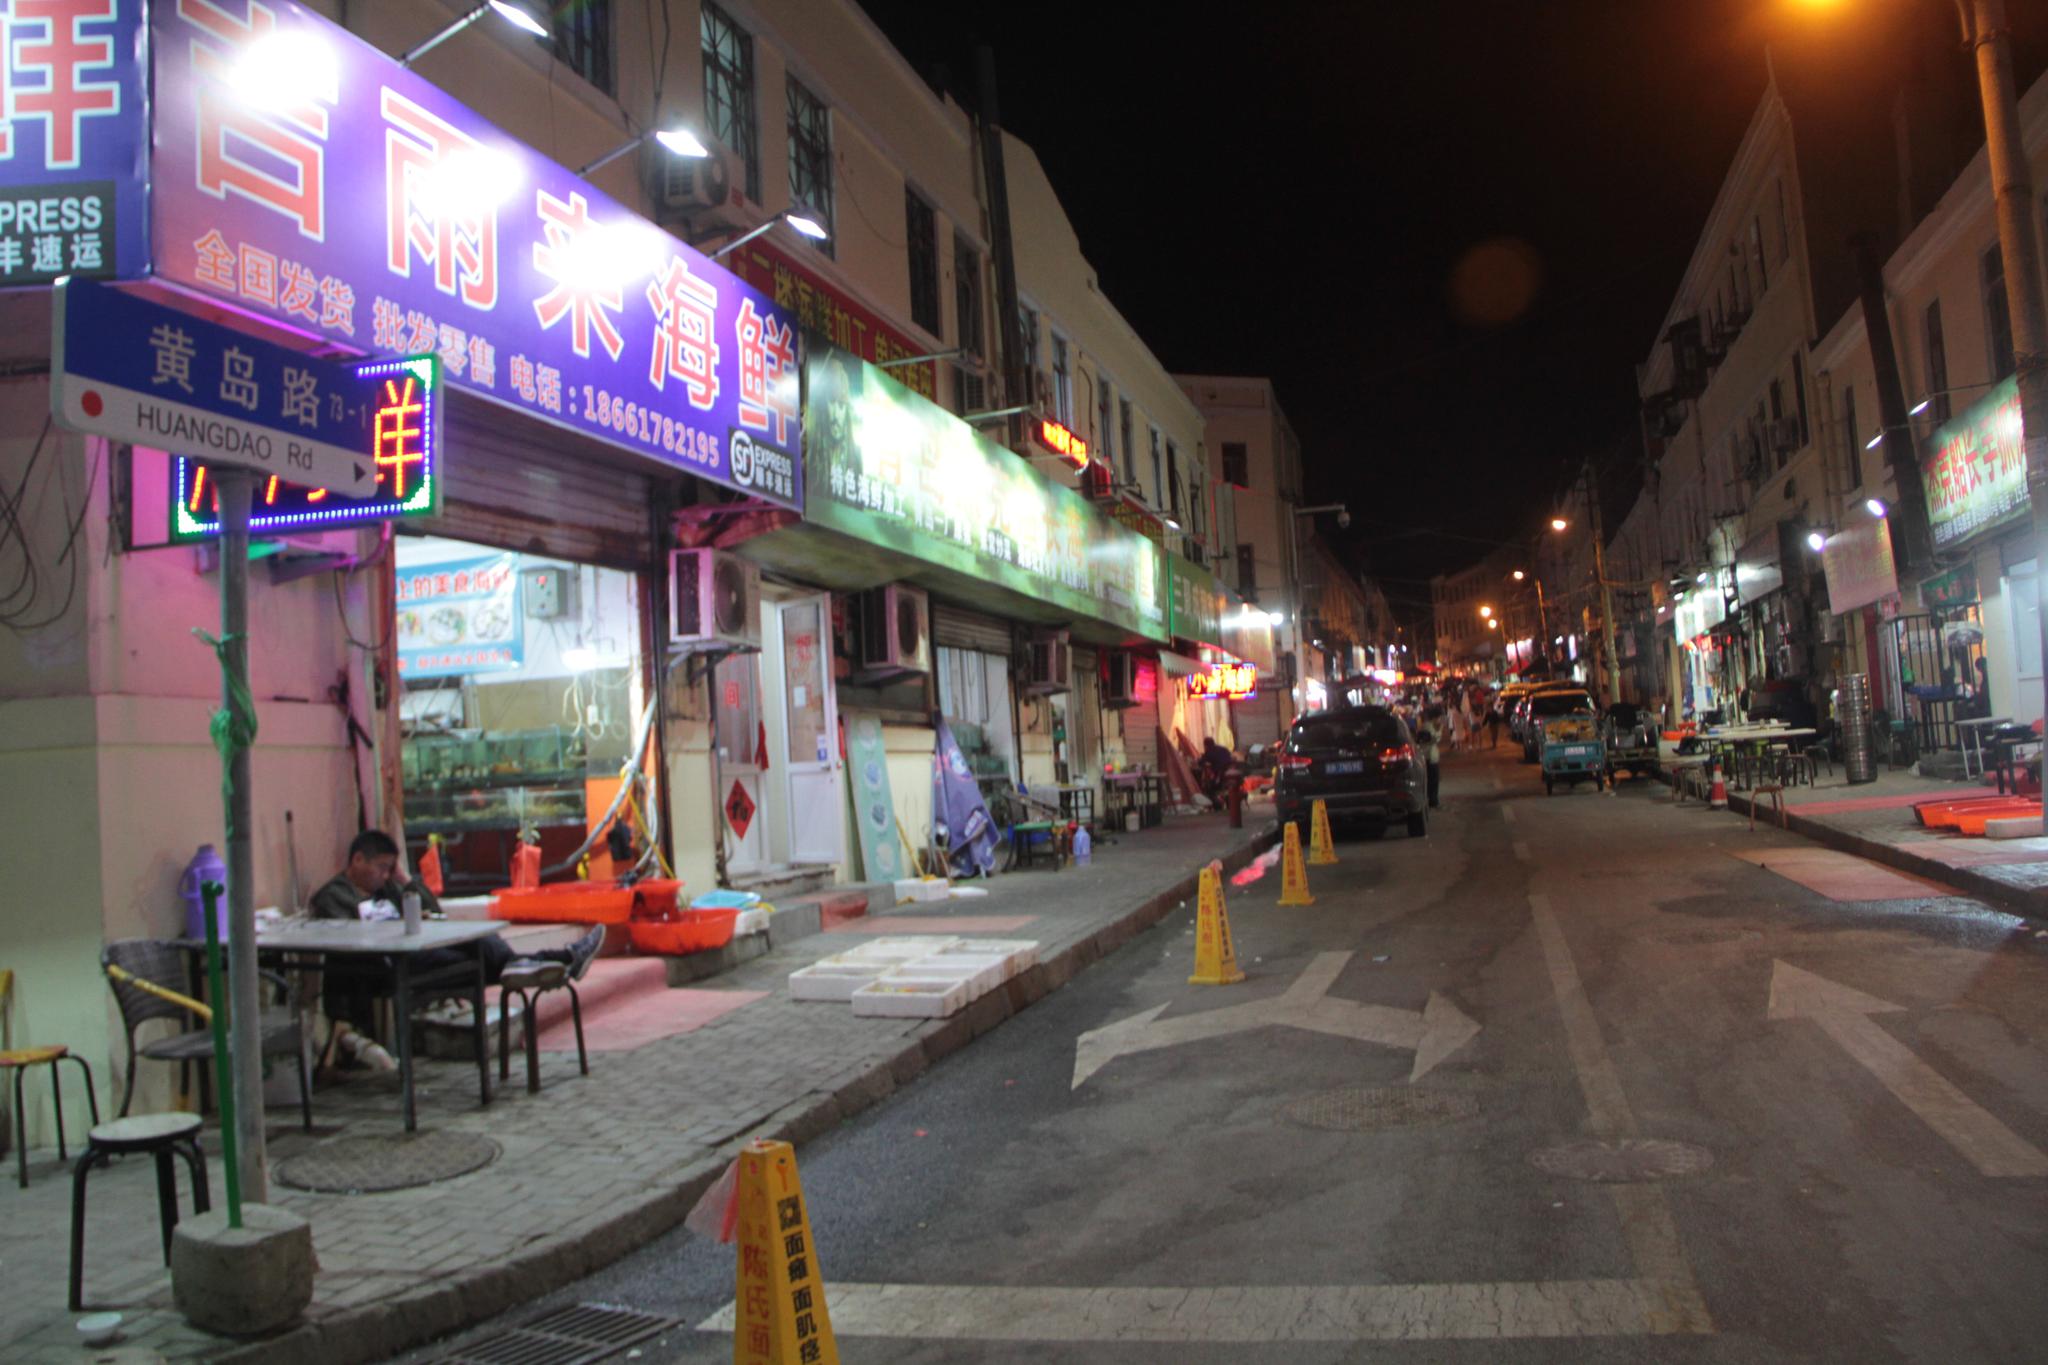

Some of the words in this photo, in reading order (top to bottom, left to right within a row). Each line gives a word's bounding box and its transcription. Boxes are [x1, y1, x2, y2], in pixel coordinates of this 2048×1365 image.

[193, 228, 356, 337] 全国发货
[372, 297, 497, 389] 批发零售
[148, 324, 321, 429] 黄岛路
[136, 401, 273, 460] HUANGDAO
[287, 442, 314, 471] Rd
